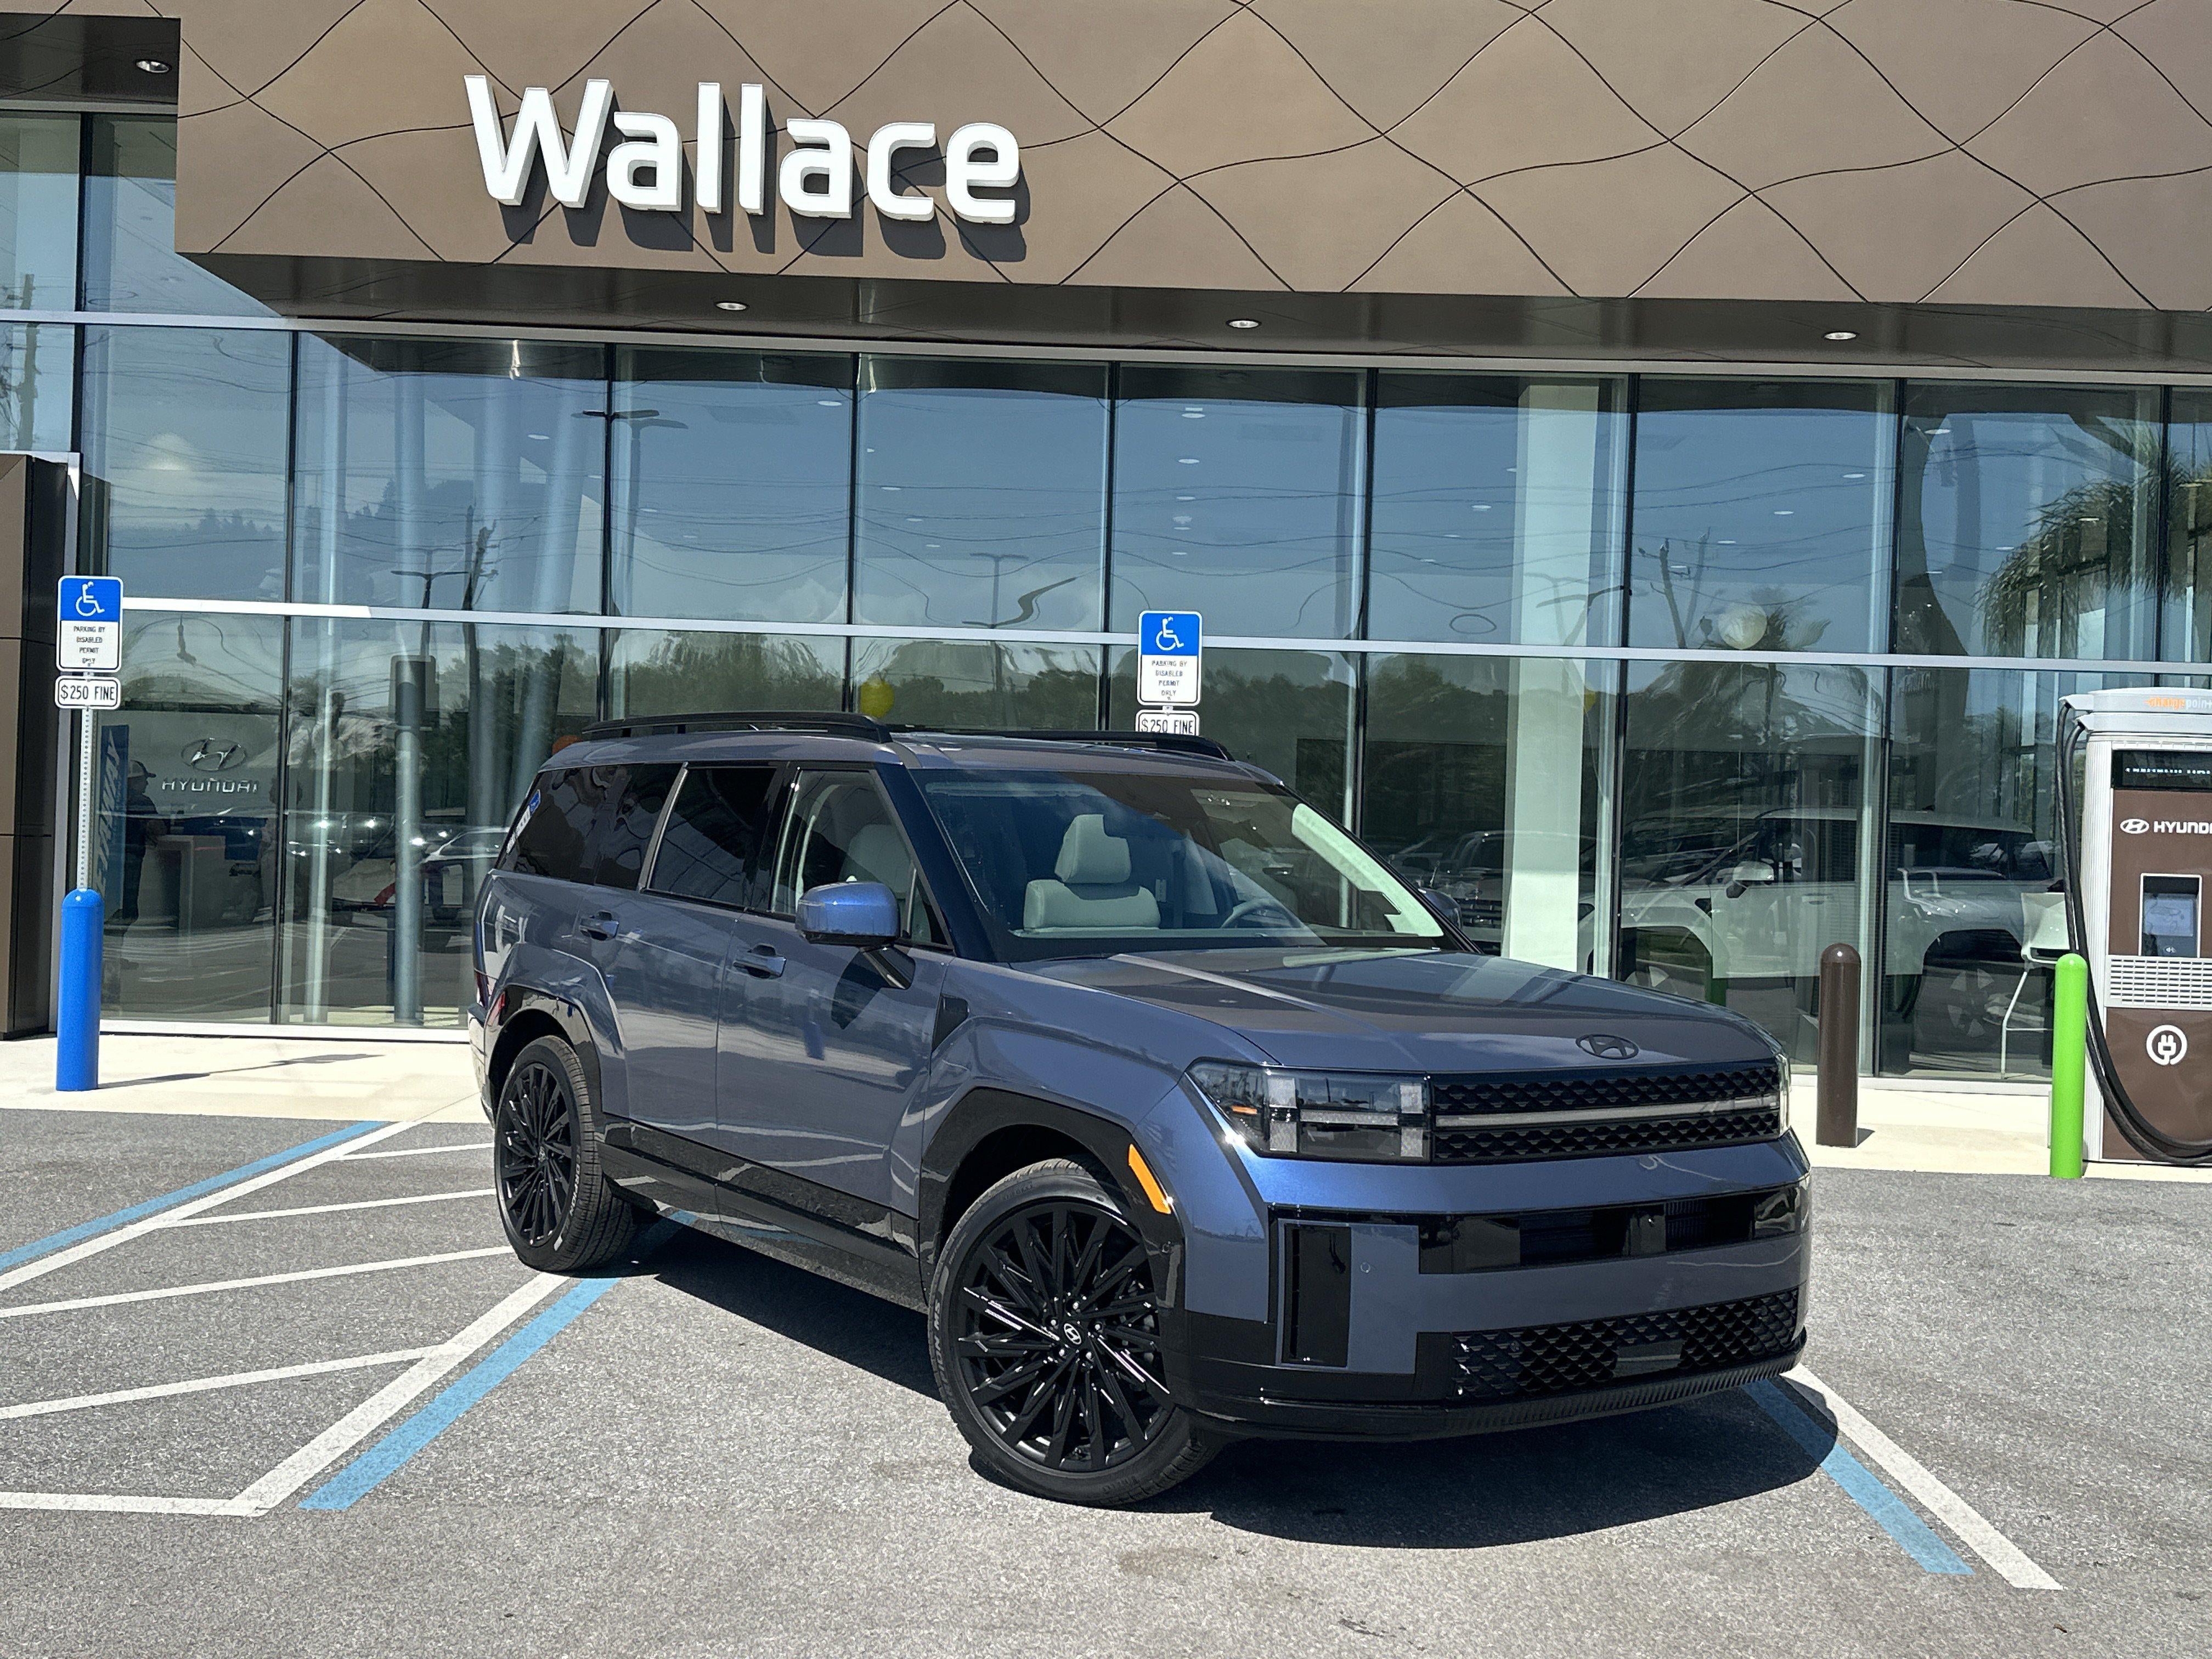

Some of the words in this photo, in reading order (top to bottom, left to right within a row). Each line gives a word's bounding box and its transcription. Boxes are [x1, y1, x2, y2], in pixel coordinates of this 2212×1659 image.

[464, 75, 1021, 224] Wallace
[60, 684, 89, 701] $250
[94, 686, 115, 701] FINE
[1141, 718, 1169, 733] $250
[1173, 719, 1194, 735] FINE
[161, 777, 258, 793] HYUNDAI
[95, 729, 121, 899] ETAWAY
[2153, 821, 2212, 834] HYUND
